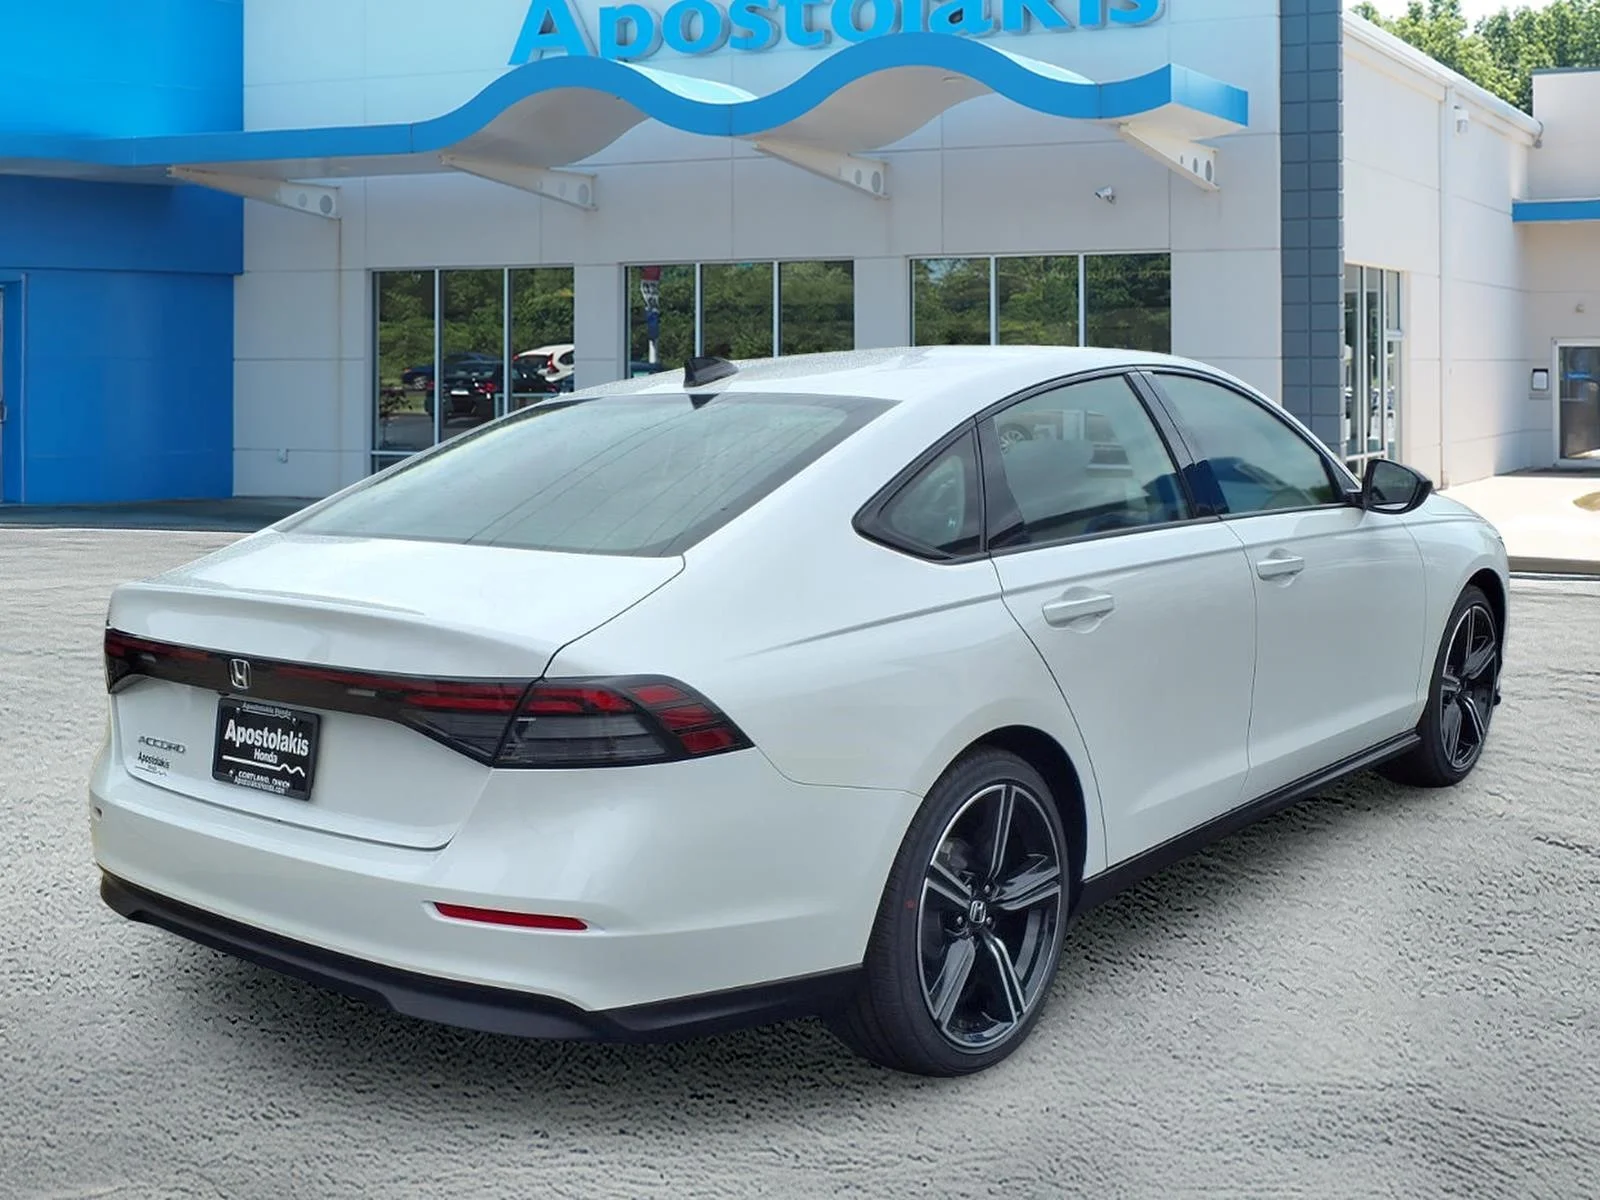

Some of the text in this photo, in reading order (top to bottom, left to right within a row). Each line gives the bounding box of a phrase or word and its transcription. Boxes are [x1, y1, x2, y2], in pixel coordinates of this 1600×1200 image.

[138, 736, 186, 753] ACCORD
[224, 719, 309, 756] Apostolakis
[253, 748, 278, 764] Honda
